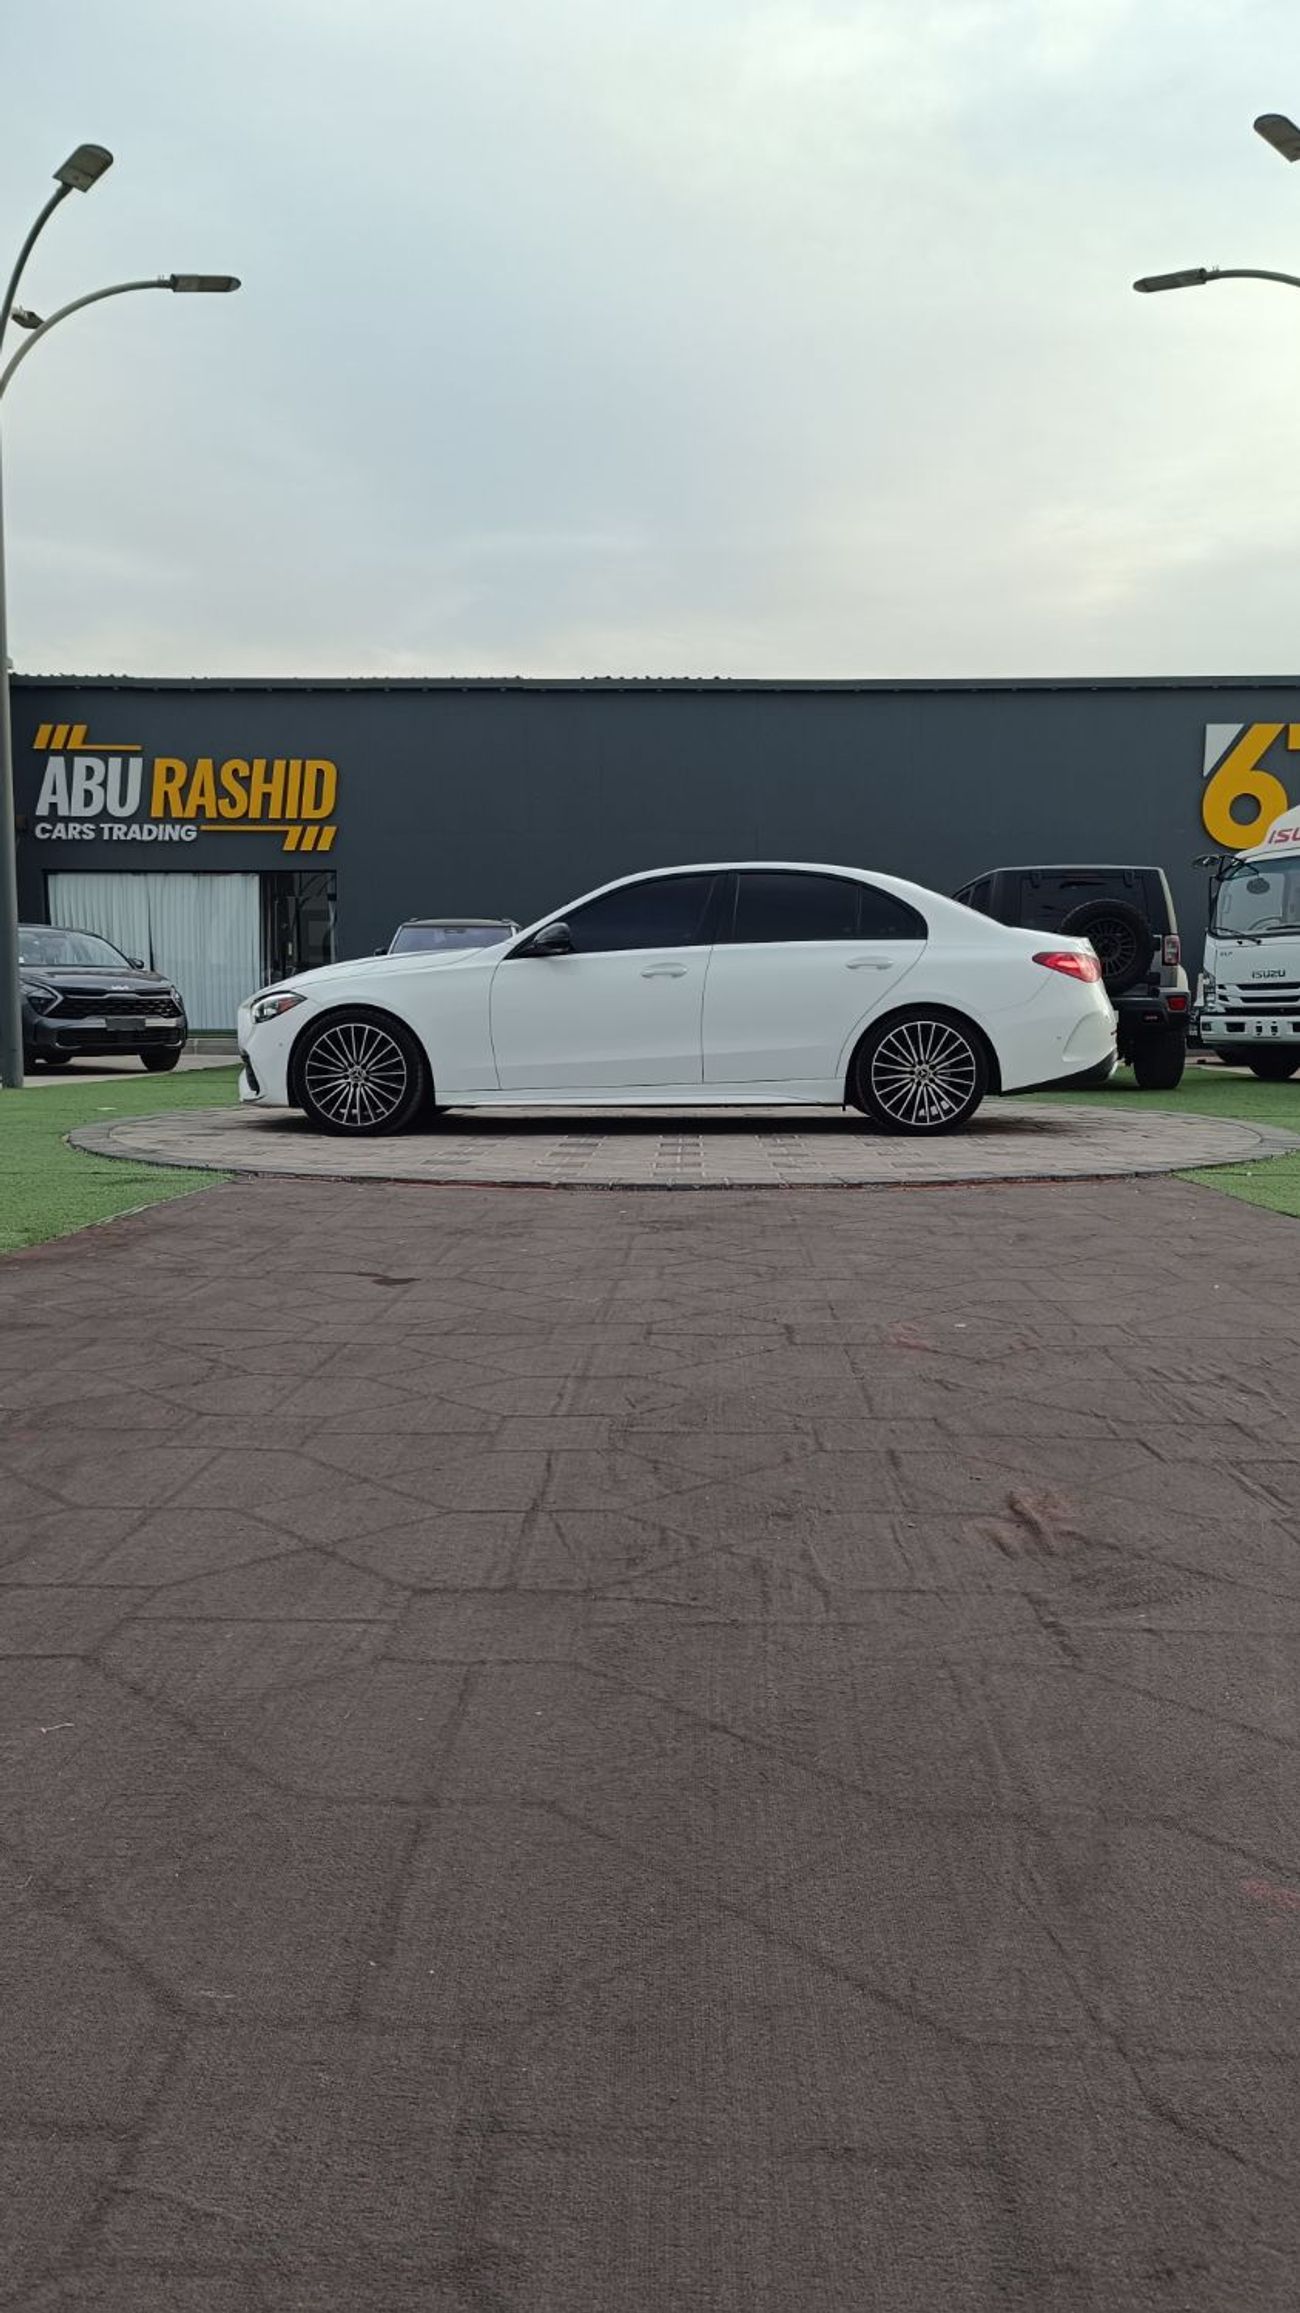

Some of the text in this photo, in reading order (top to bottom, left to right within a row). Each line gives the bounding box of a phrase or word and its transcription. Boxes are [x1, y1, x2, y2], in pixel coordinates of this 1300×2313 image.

[35, 756, 337, 819] ABU RASHID
[1202, 723, 1300, 850] 6
[35, 823, 197, 841] CARS TRADING
[1252, 969, 1286, 979] ISUZU
